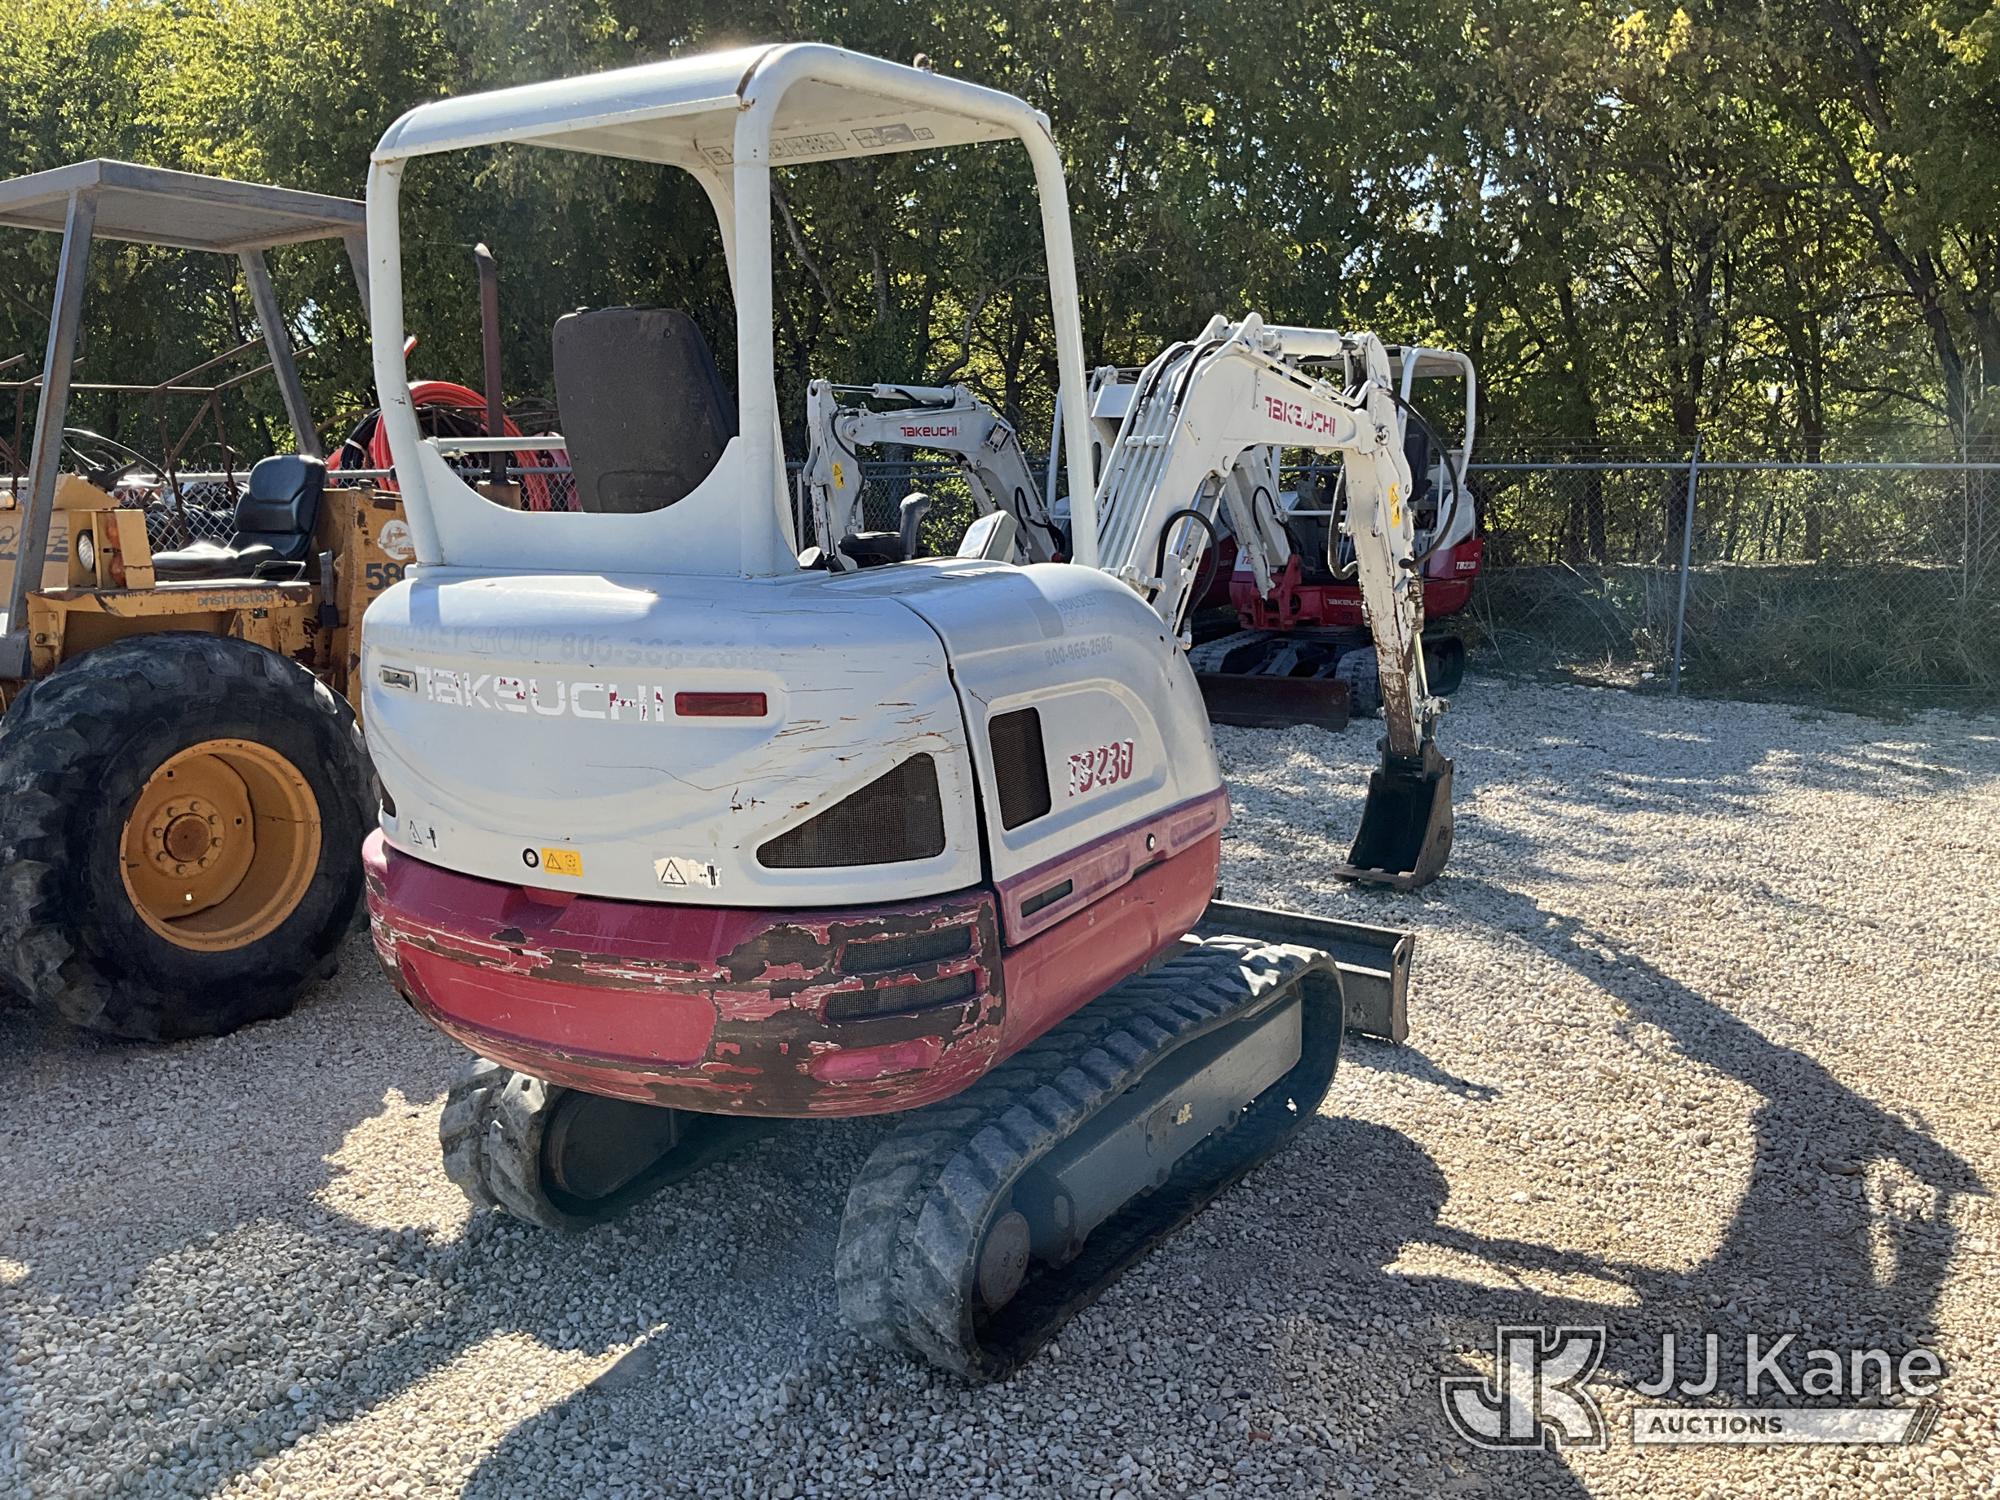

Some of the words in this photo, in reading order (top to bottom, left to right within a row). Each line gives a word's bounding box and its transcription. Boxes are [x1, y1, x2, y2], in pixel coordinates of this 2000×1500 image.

[900, 425, 958, 438] TAKEUCHI
[1326, 598, 1362, 607] TAKEUC
[415, 665, 665, 723] TAKEUCHI
[1067, 738, 1134, 798] TB230
